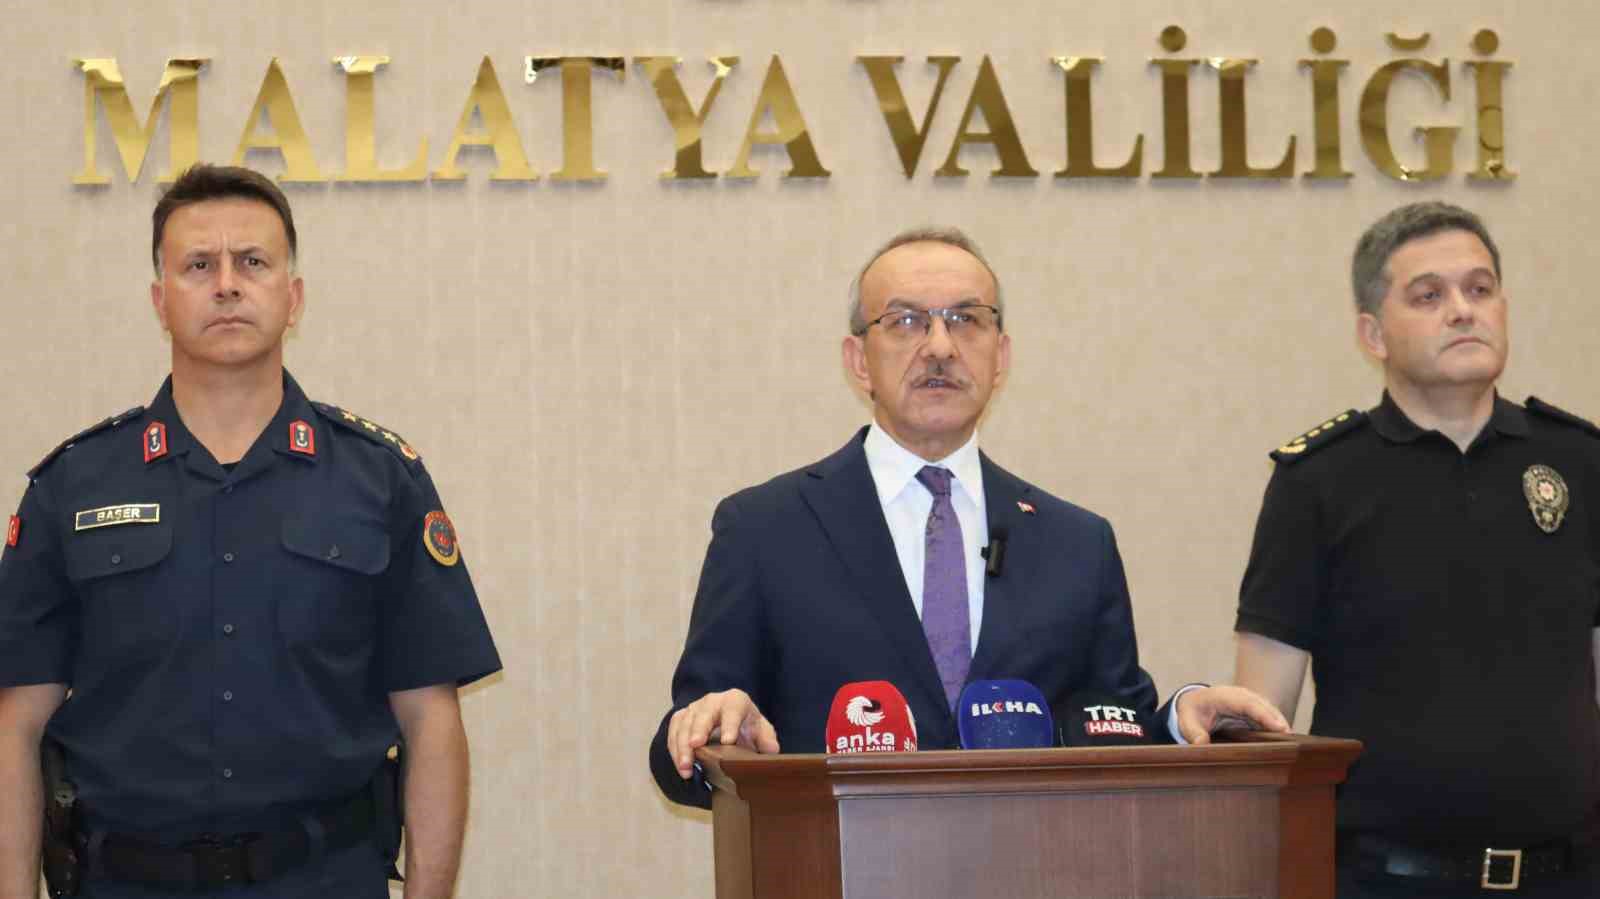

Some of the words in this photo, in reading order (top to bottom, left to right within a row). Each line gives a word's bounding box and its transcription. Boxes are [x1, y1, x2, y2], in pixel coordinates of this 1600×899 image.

[72, 54, 832, 184] MALATYA
[856, 25, 1518, 183] VALİLİĞİ
[1083, 705, 1137, 722] TRT
[836, 726, 895, 750] anka
[1088, 721, 1143, 737] HABER
